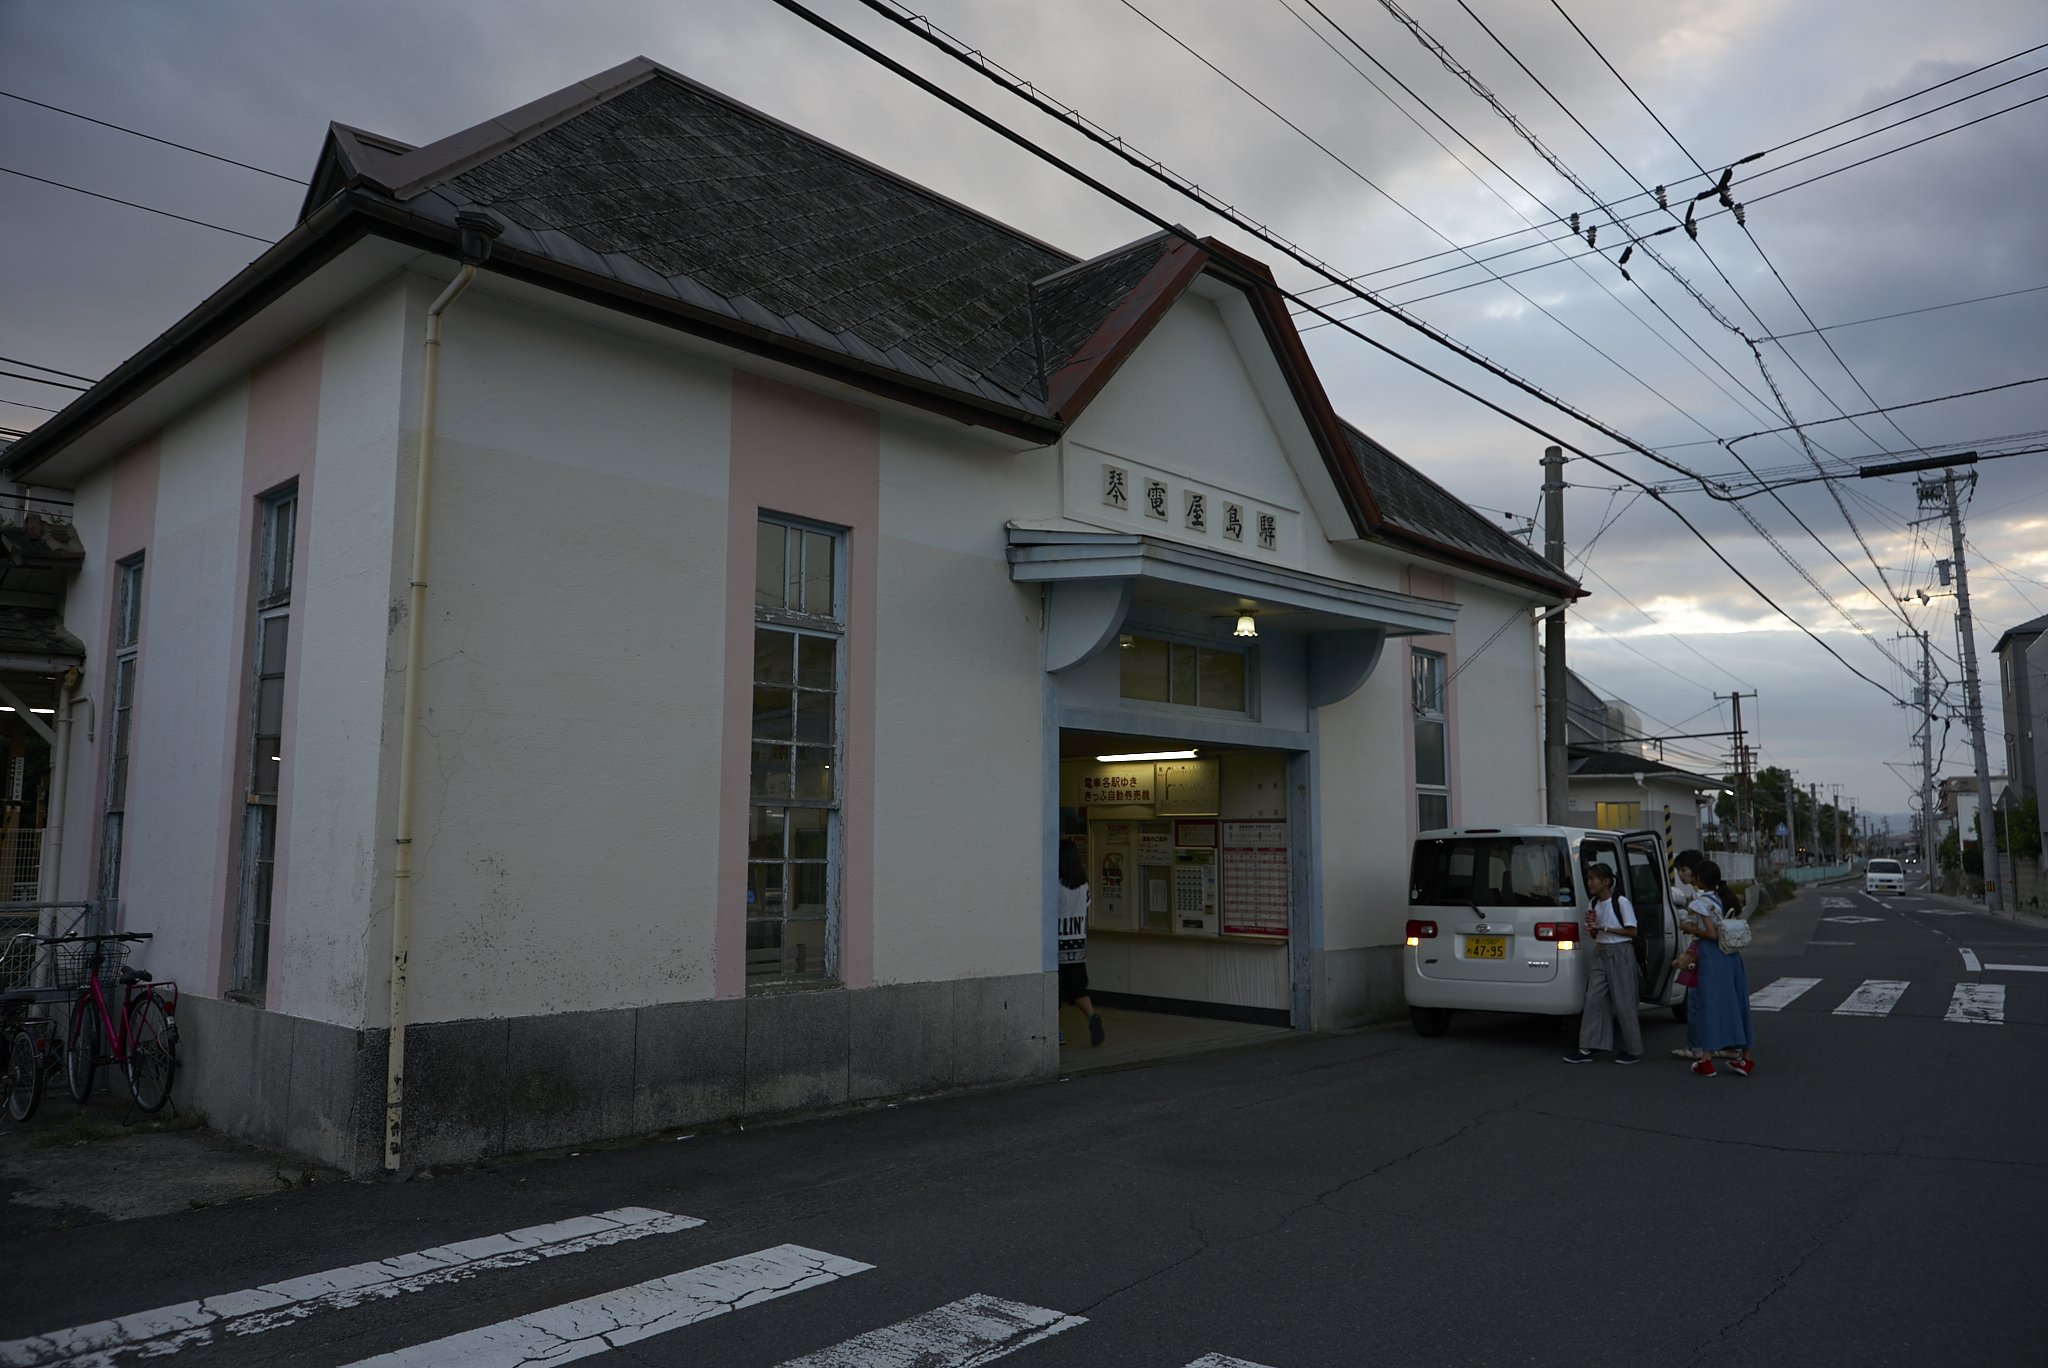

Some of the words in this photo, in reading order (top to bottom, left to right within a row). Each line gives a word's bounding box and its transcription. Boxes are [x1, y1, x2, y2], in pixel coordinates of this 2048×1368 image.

[1106, 470, 1276, 546] 琴電屋島驛
[1084, 776, 1137, 788] 電車各駅ゆき
[1084, 790, 1150, 802] きっぷ自動券売機
[1473, 945, 1503, 957] 47-95
